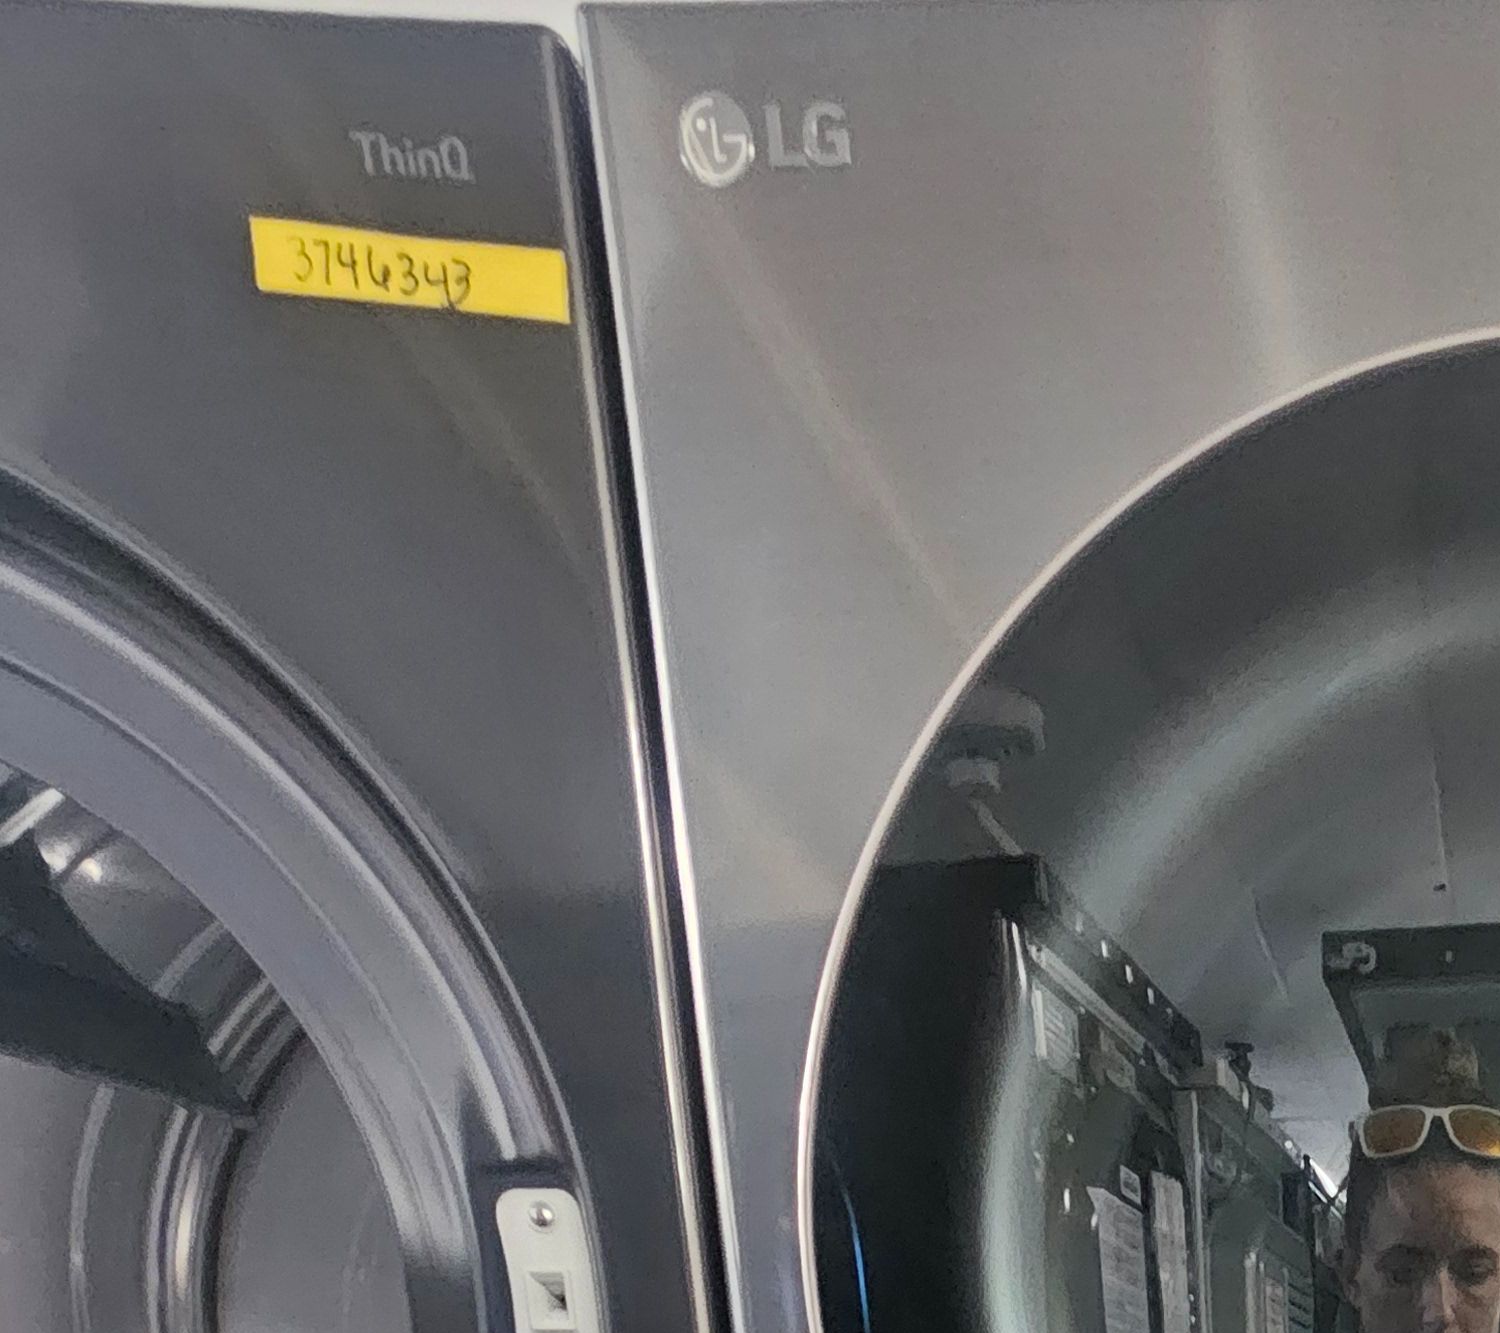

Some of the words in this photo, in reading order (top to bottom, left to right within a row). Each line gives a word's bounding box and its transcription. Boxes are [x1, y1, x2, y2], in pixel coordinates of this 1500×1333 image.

[349, 129, 476, 184] ThinQ
[762, 102, 852, 167] LG
[289, 234, 473, 312] 3746343
